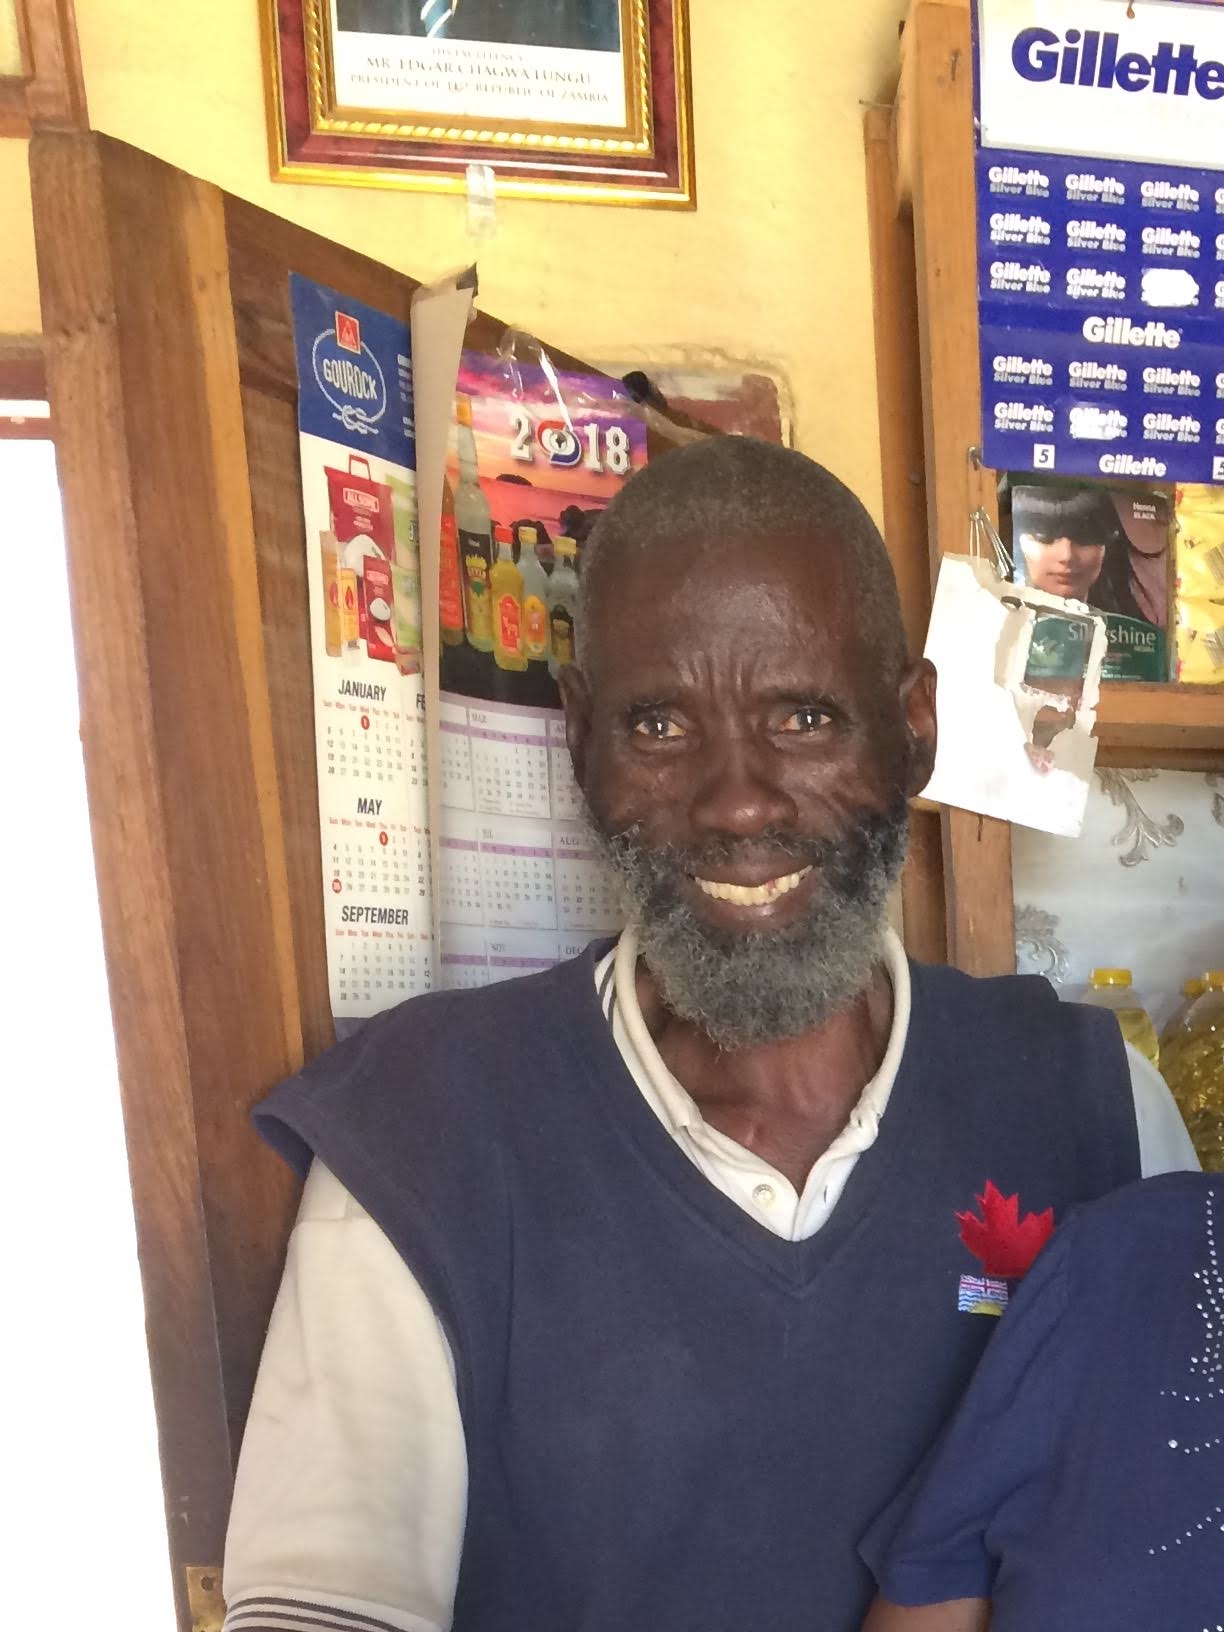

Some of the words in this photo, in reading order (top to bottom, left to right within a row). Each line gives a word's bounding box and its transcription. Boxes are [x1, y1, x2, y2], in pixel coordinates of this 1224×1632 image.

[988, 166, 1050, 188] Gillette
[1065, 174, 1125, 195] Gillette
[1140, 181, 1200, 202] Gillette
[989, 213, 1051, 235] Gillette
[1066, 220, 1127, 242] Gillette
[1141, 227, 1200, 249] Gillette
[989, 261, 1051, 283] Gillette
[1066, 268, 1126, 290] Gillette
[1082, 316, 1181, 349] Gillette
[992, 355, 1053, 376] Gillette
[1068, 361, 1127, 382] Gillette
[323, 358, 378, 400] GOUROCK
[1142, 367, 1200, 388] Gillette
[993, 402, 1054, 423] Gillette
[1142, 413, 1201, 434] Gillette
[1038, 449, 1050, 463] 5
[1098, 454, 1167, 477] Gillette
[338, 679, 387, 702] JANUARY
[357, 797, 383, 816] MAY
[341, 905, 409, 926] SEPTEMBER
